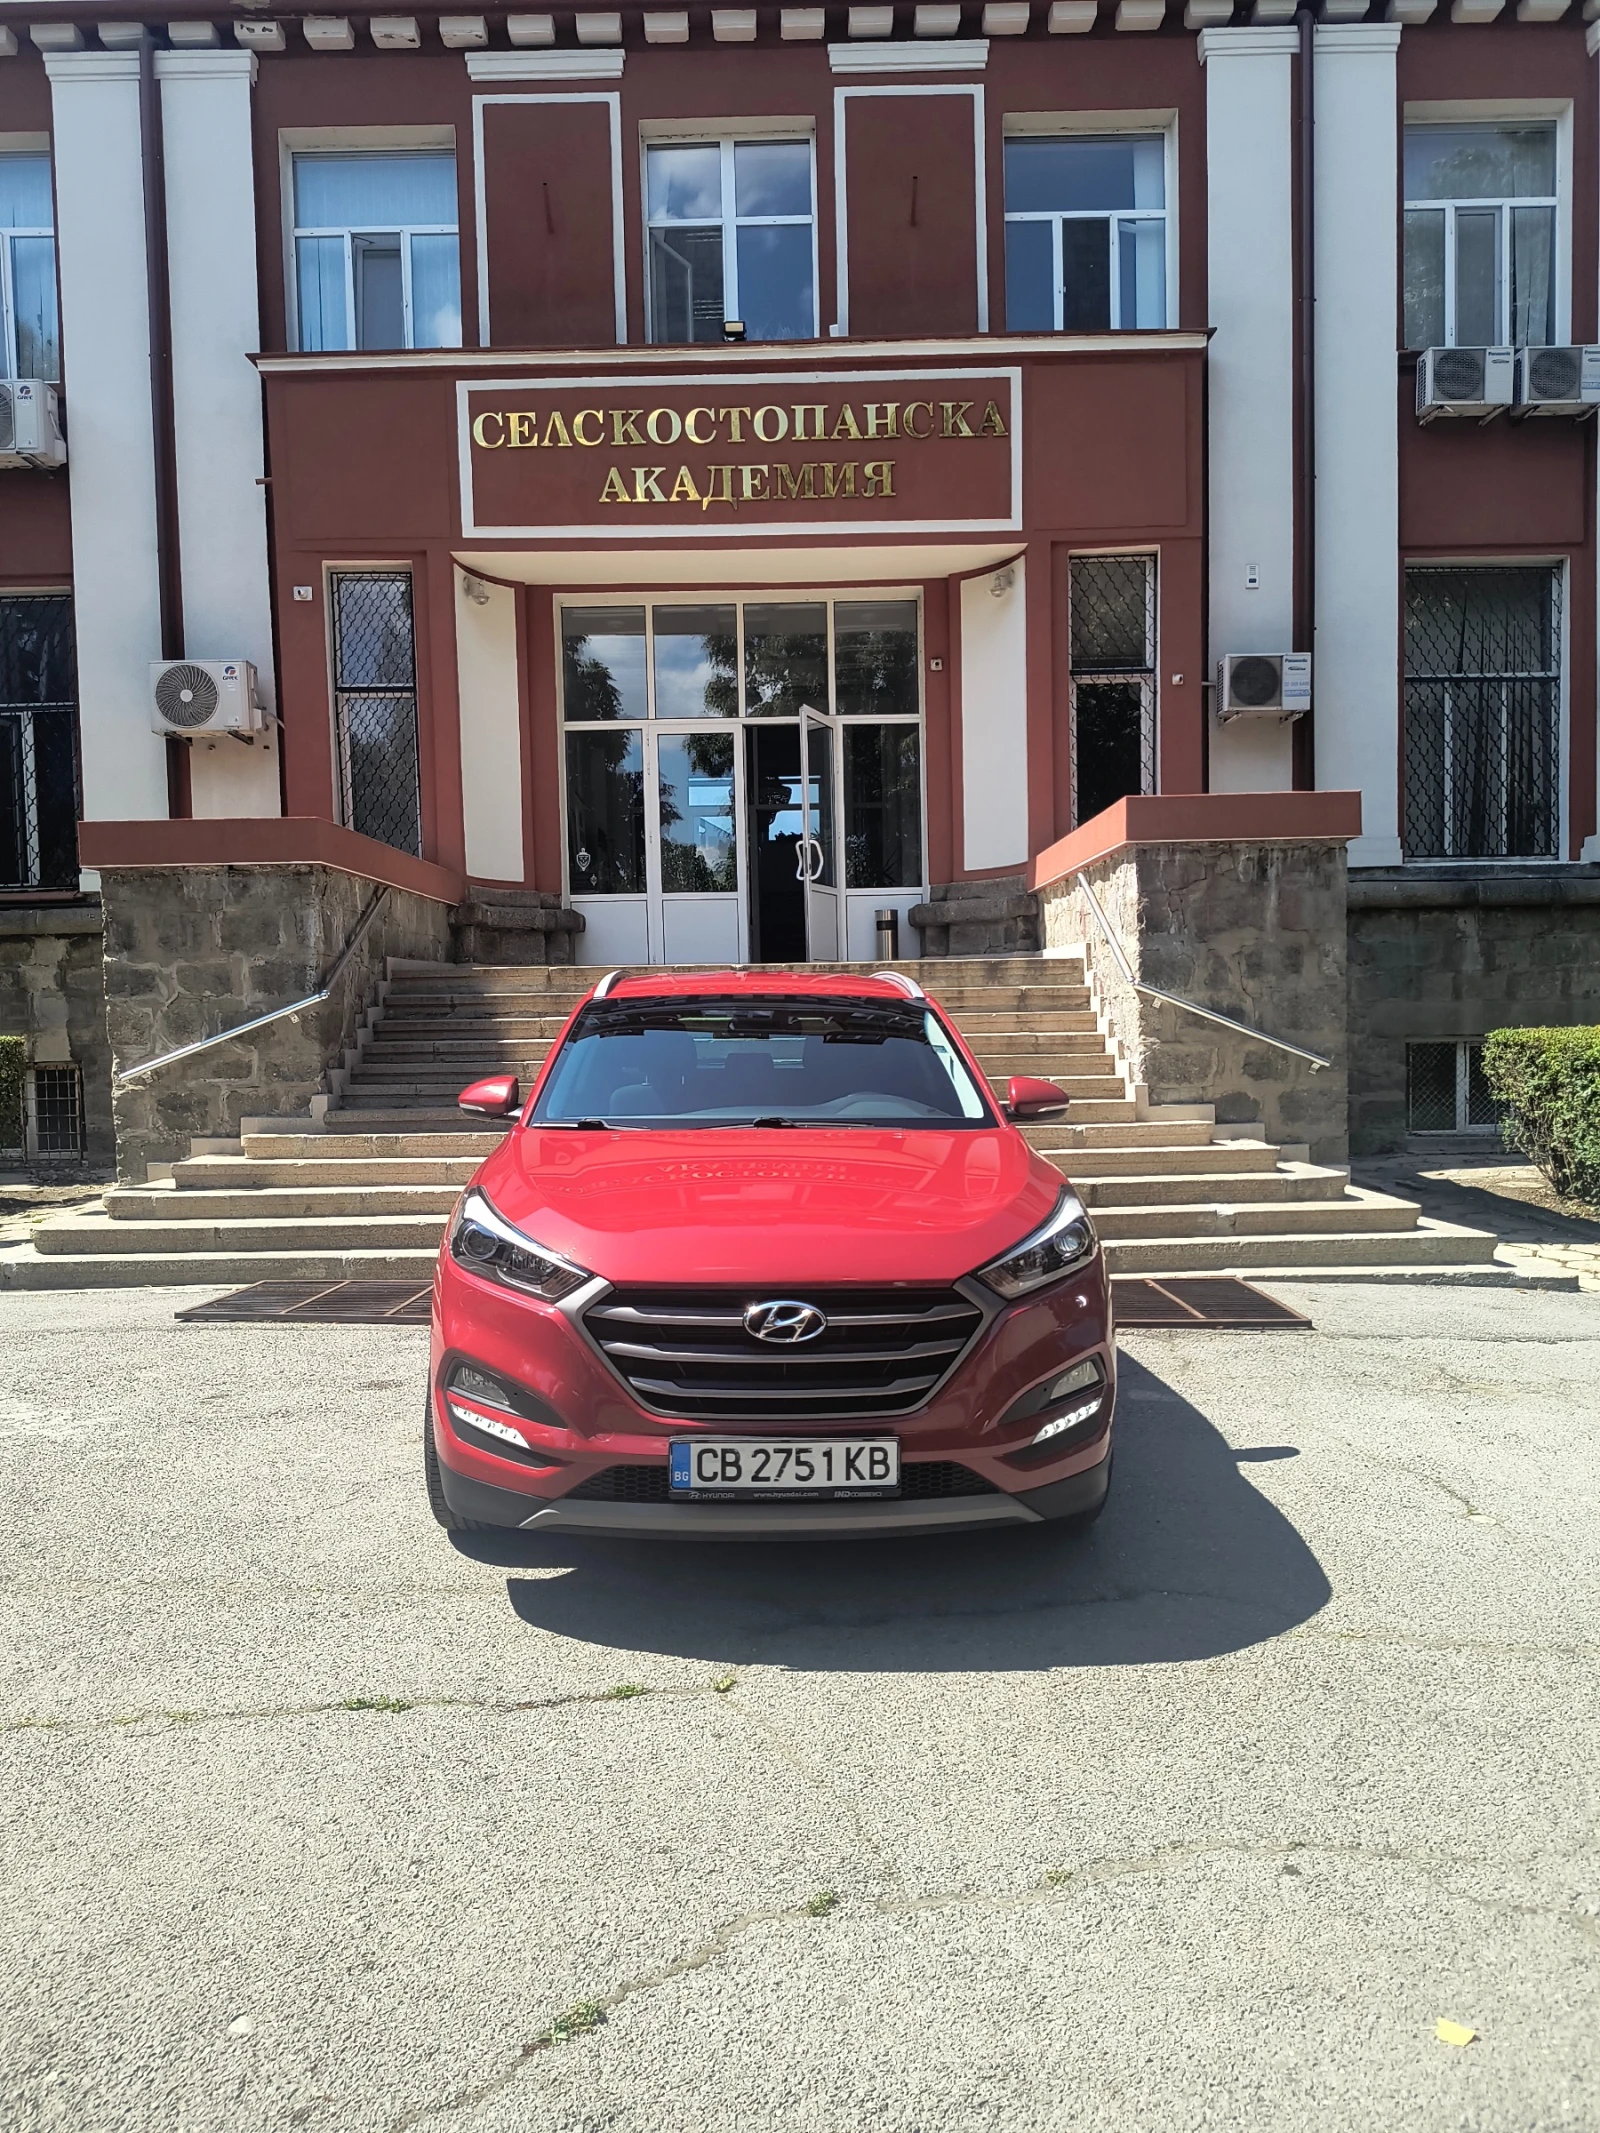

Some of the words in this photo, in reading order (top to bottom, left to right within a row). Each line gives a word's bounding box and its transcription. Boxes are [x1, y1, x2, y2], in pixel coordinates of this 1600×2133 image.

[472, 401, 1008, 448] СЕЛСКОСТОПАНСКА
[599, 460, 897, 511] АКАДЕМИЯ
[674, 1471, 689, 1482] BG
[697, 1447, 743, 1482] CB
[751, 1447, 833, 1482] 2751
[845, 1446, 891, 1481] KB
[753, 1491, 819, 1499] www.hyundai.com
